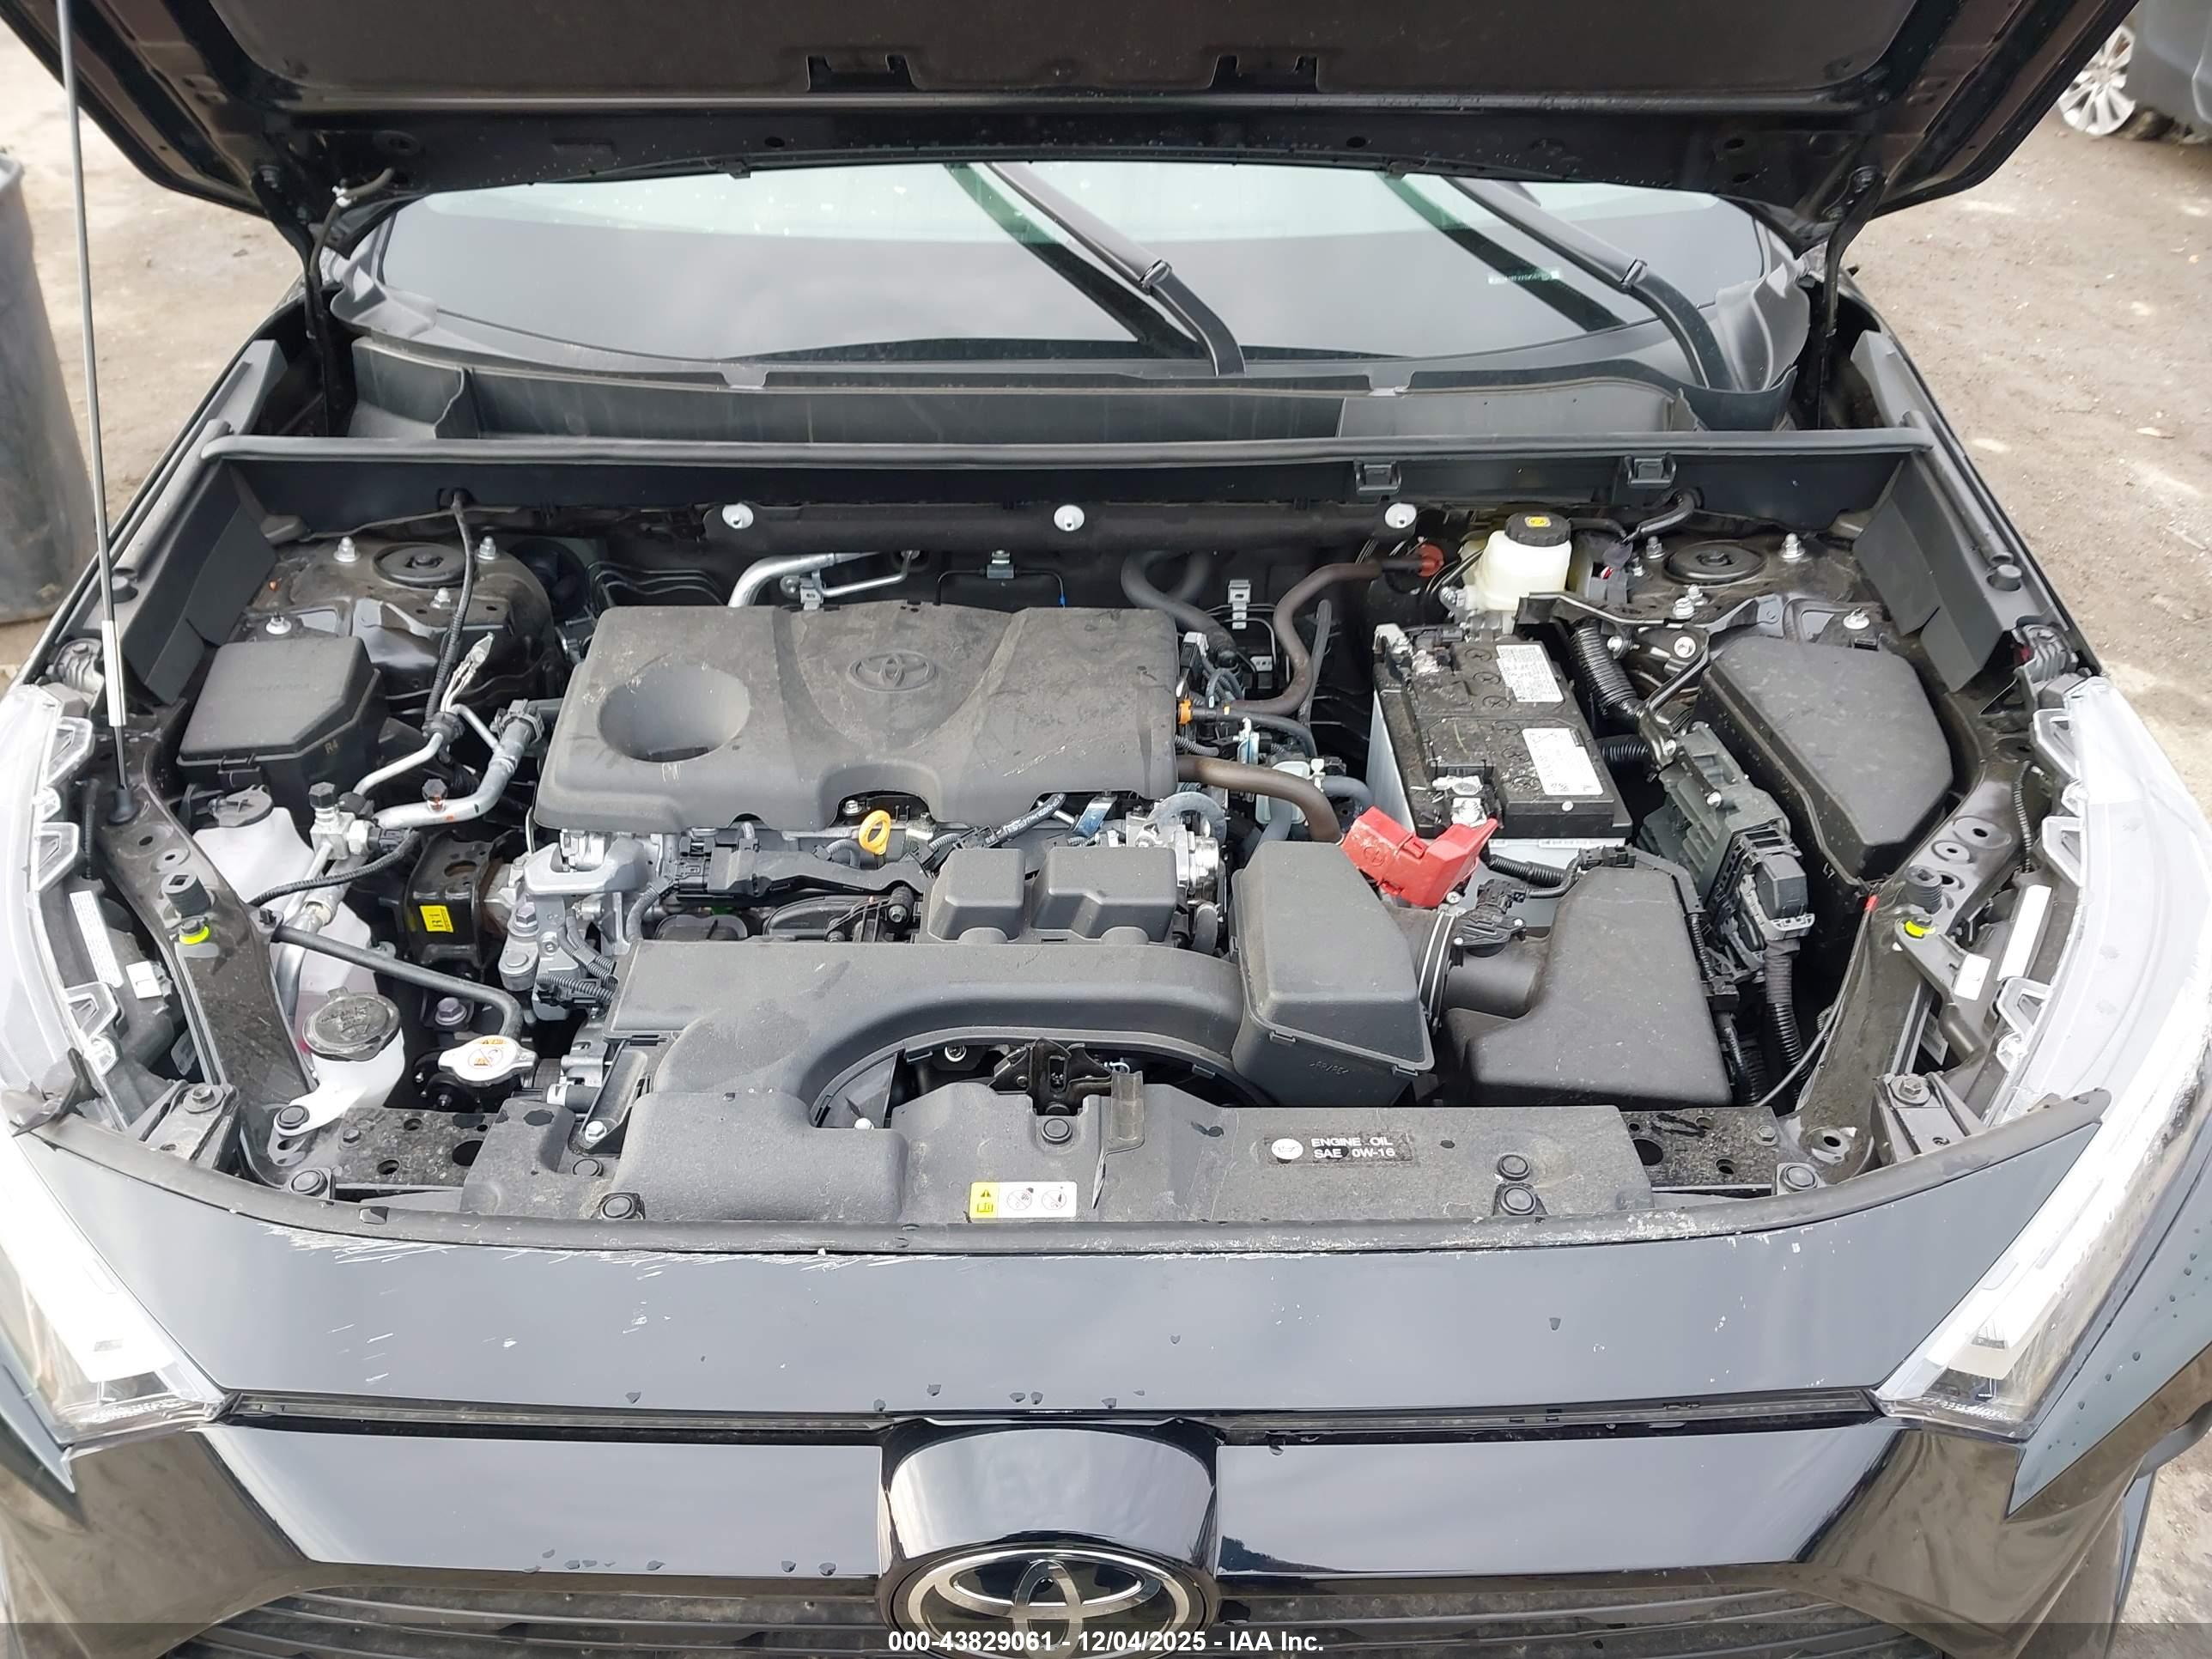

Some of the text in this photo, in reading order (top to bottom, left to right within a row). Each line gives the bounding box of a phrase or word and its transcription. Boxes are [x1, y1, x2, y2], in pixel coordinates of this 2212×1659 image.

[1311, 1137, 1393, 1147] ENGINE OIL
[1314, 1147, 1395, 1158] SAE 0W-16
